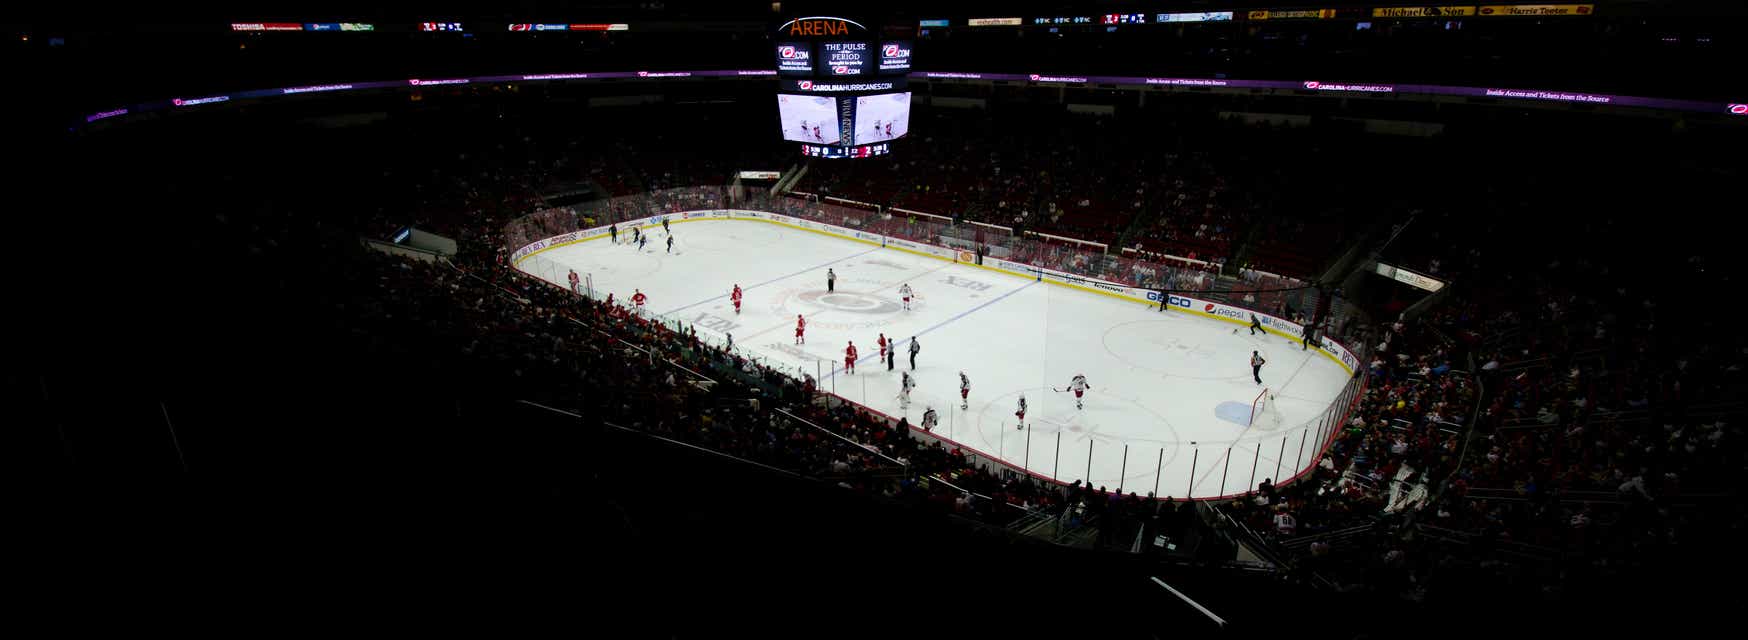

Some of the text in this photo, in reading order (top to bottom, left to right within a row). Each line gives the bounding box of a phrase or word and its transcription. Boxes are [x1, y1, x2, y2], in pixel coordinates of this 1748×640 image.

[1382, 7, 1425, 16] Michael
[1444, 7, 1465, 16] Son
[1509, 7, 1569, 15] Harris Teeter
[790, 18, 848, 36] ARENA
[825, 43, 866, 51] THE PULSE
[832, 53, 860, 61] PERIOD
[812, 82, 893, 92] CAROLINAHURRICANES.COM
[1504, 90, 1525, 98] Access
[842, 120, 852, 146] NEWS
[822, 147, 829, 155] 0
[865, 146, 872, 154] 2
[1146, 291, 1191, 308] GECO
[1217, 308, 1244, 319] pepsi
[1342, 350, 1354, 370] REX
